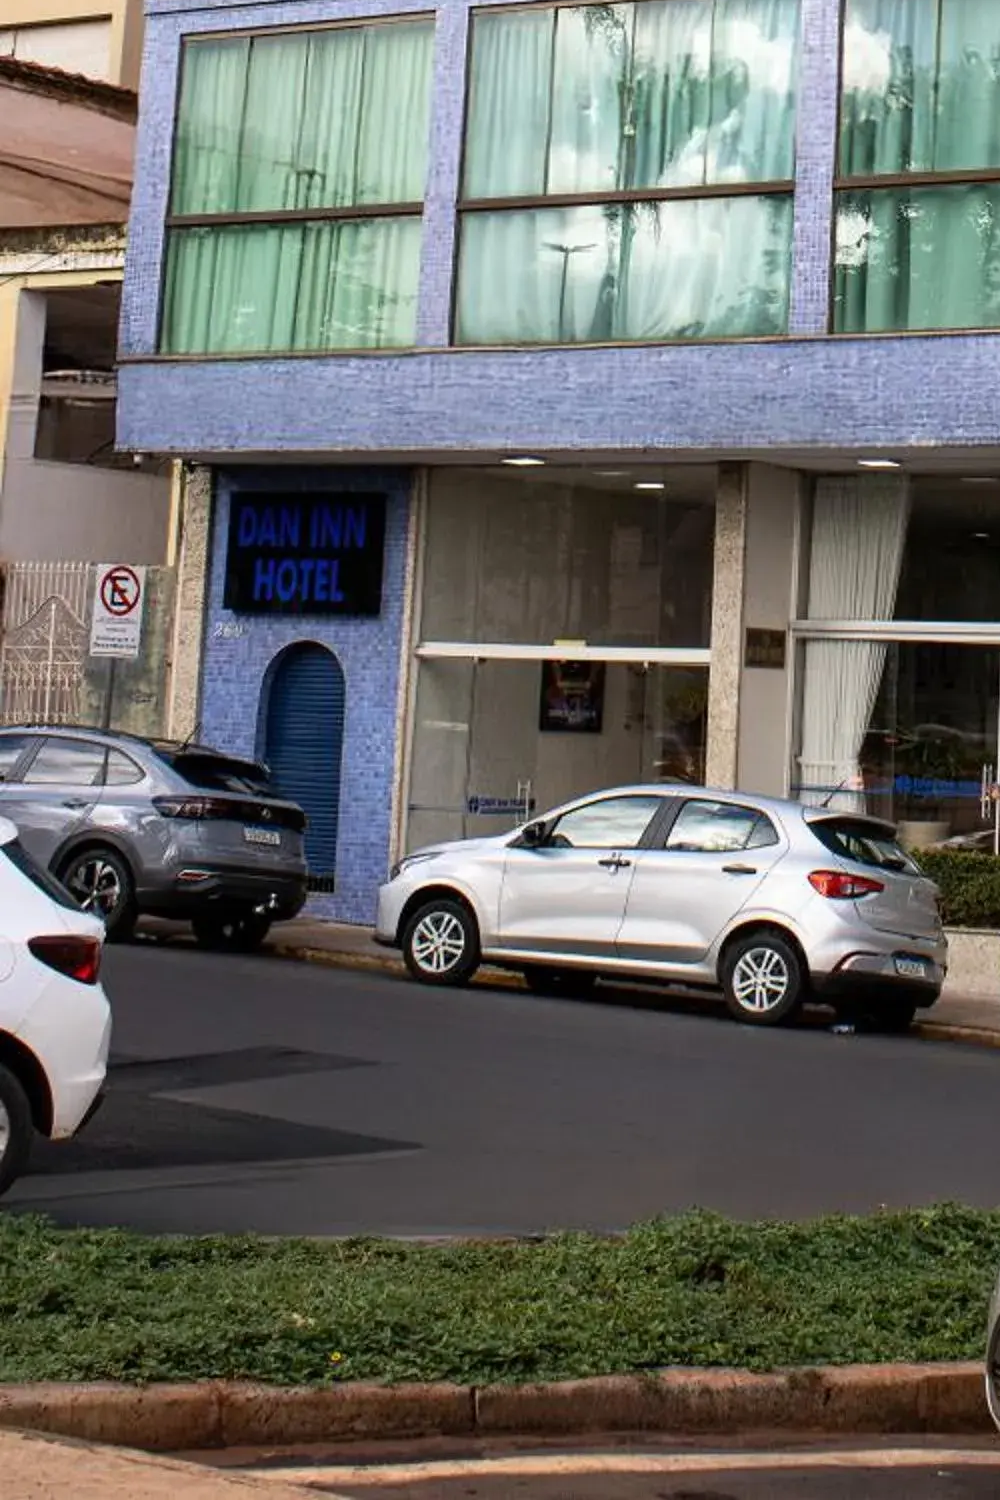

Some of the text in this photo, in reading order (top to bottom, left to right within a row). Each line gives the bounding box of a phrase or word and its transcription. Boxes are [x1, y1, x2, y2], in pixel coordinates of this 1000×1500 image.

[238, 501, 367, 548] DAN INN
[252, 558, 344, 603] HOTEL
